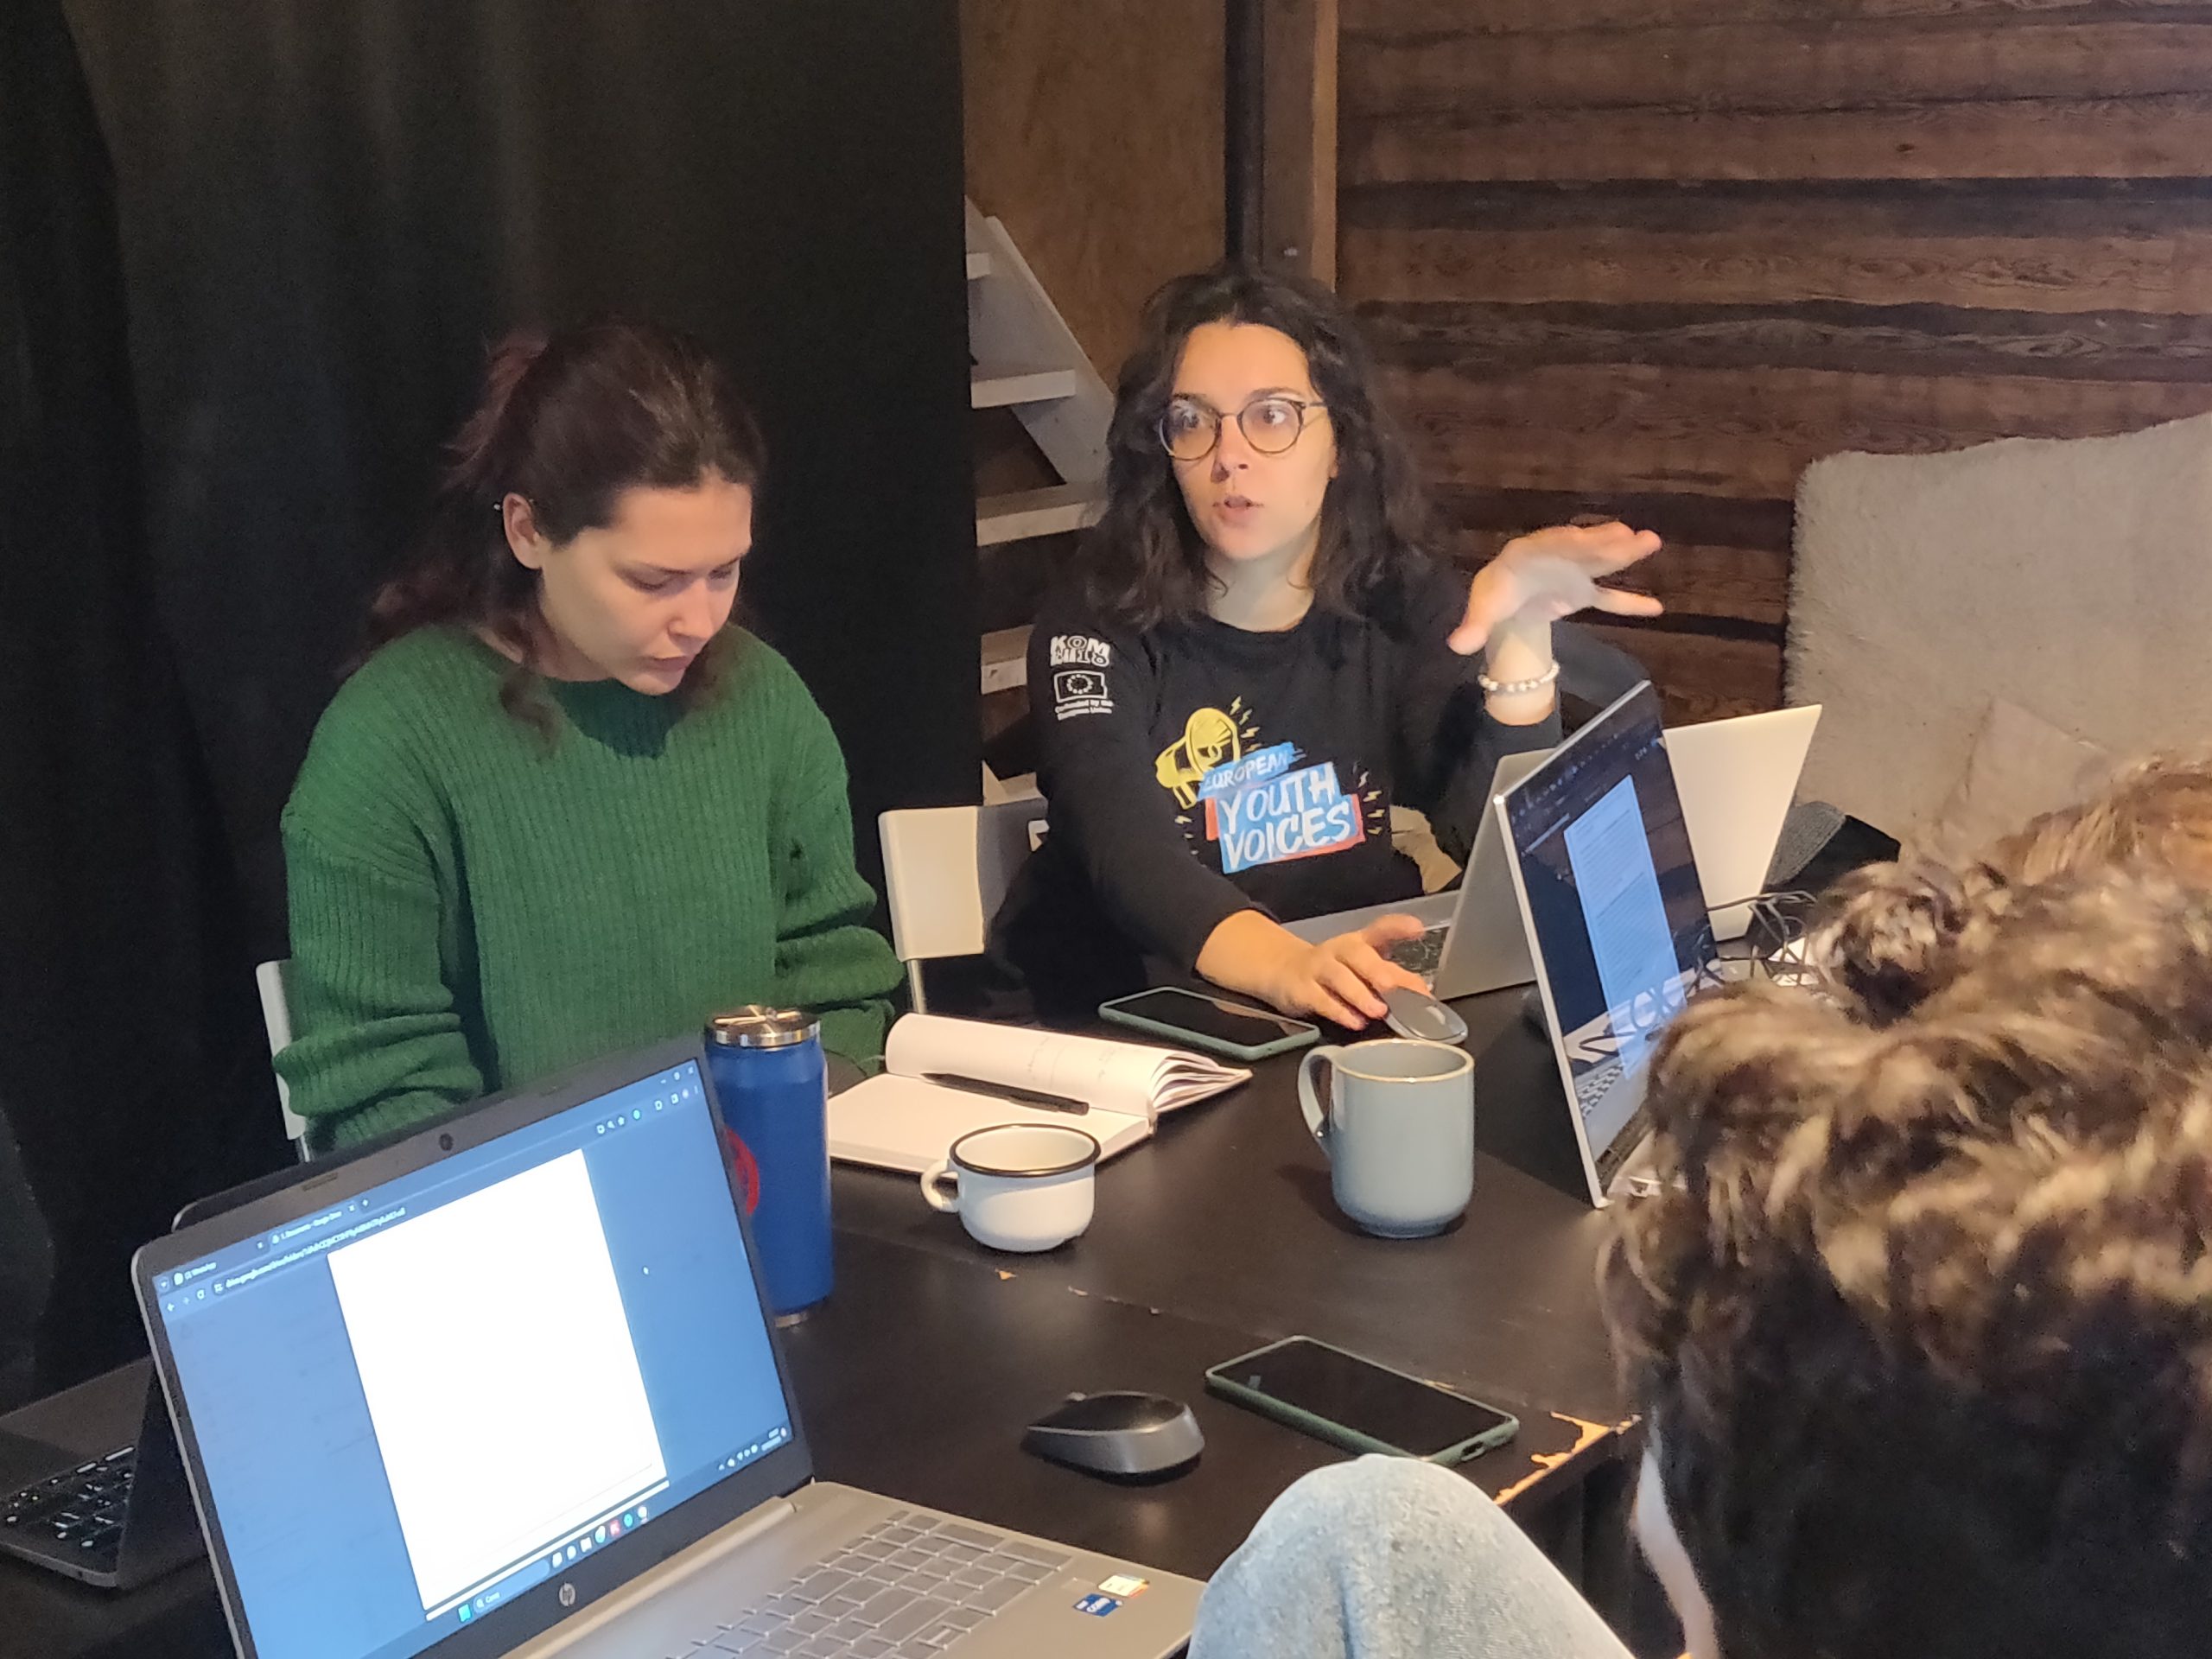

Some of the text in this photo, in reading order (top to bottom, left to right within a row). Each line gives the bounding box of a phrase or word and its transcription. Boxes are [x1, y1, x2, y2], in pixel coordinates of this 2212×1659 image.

[1205, 752, 1288, 791] EUROPEAN
[1220, 761, 1336, 835] YOUTH
[1224, 801, 1351, 871] VOICES
